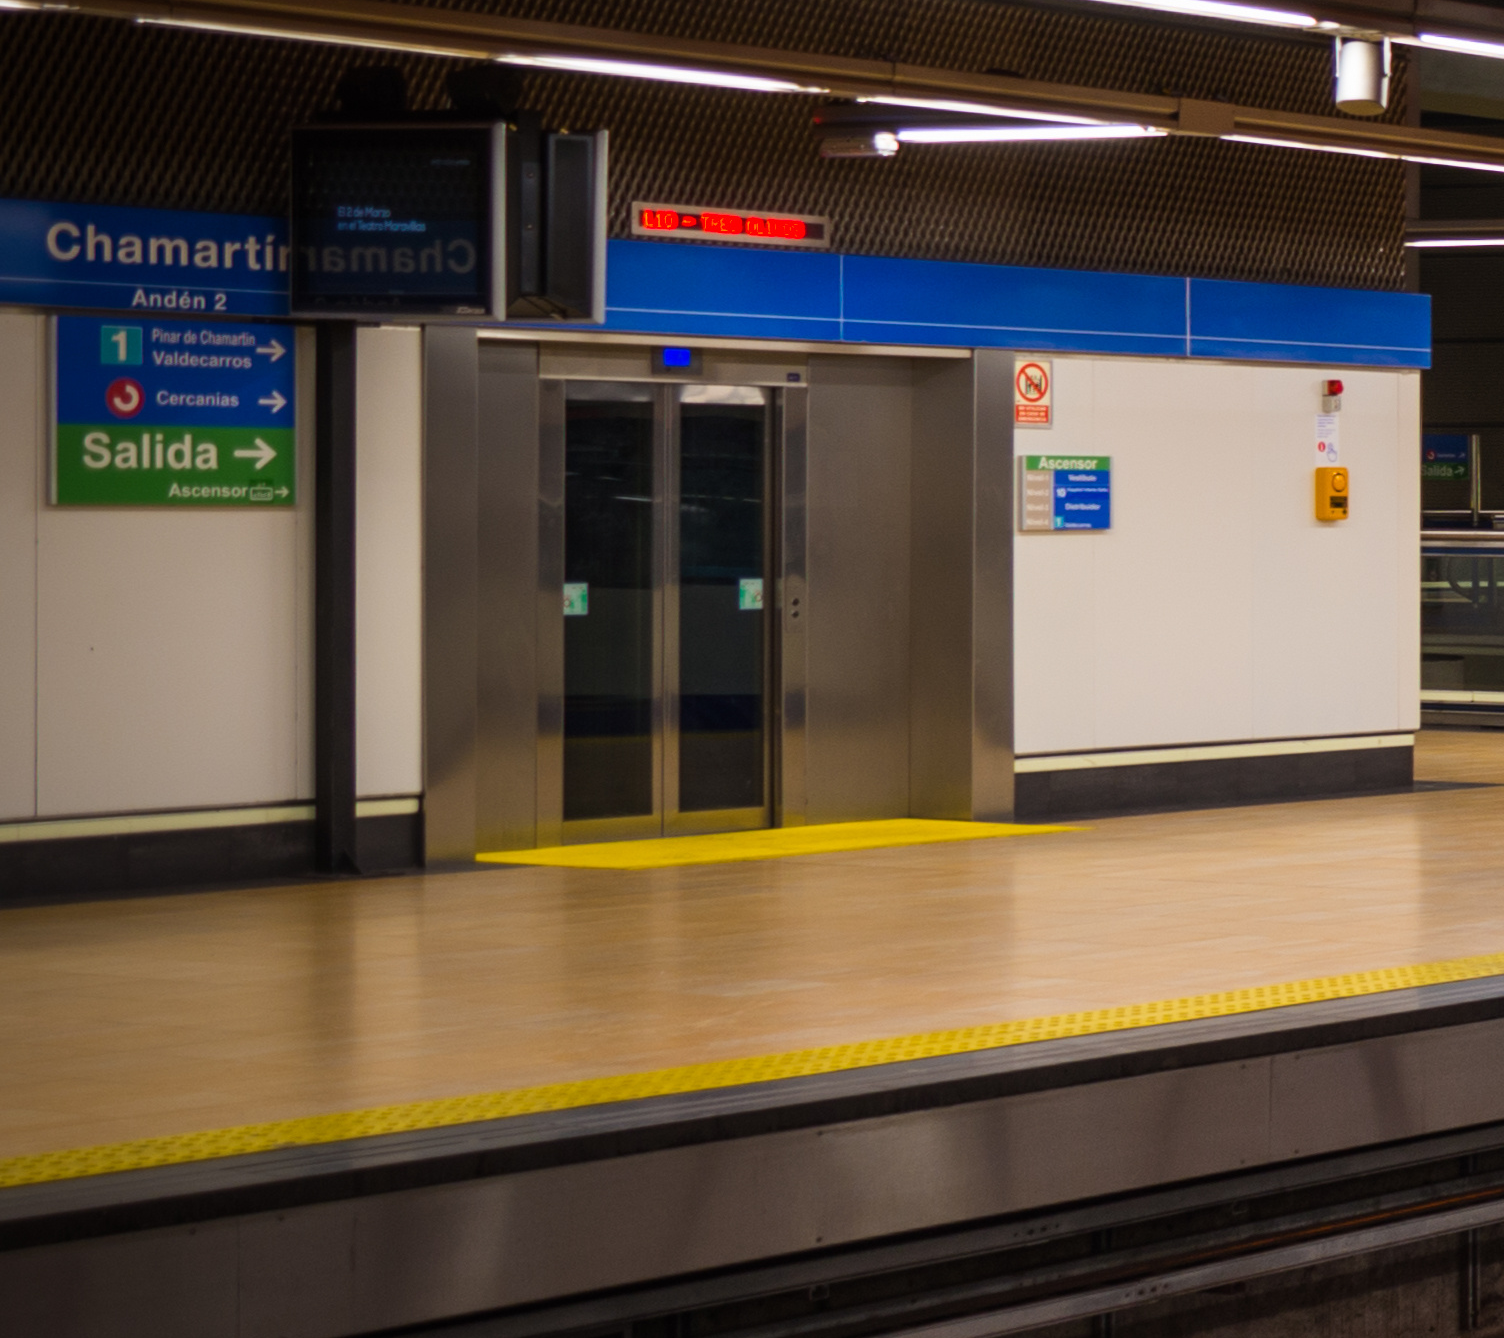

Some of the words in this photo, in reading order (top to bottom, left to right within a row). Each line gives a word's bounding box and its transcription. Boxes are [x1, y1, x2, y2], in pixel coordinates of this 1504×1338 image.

[132, 288, 206, 309] Andén
[214, 293, 227, 310] 2
[152, 328, 181, 343] Pinar
[184, 330, 197, 344] de
[112, 331, 127, 361] 1
[152, 351, 252, 369] Valdecarros
[83, 432, 218, 469] Salida
[1038, 456, 1098, 469] Ascensor
[169, 483, 249, 498] Ascensor
